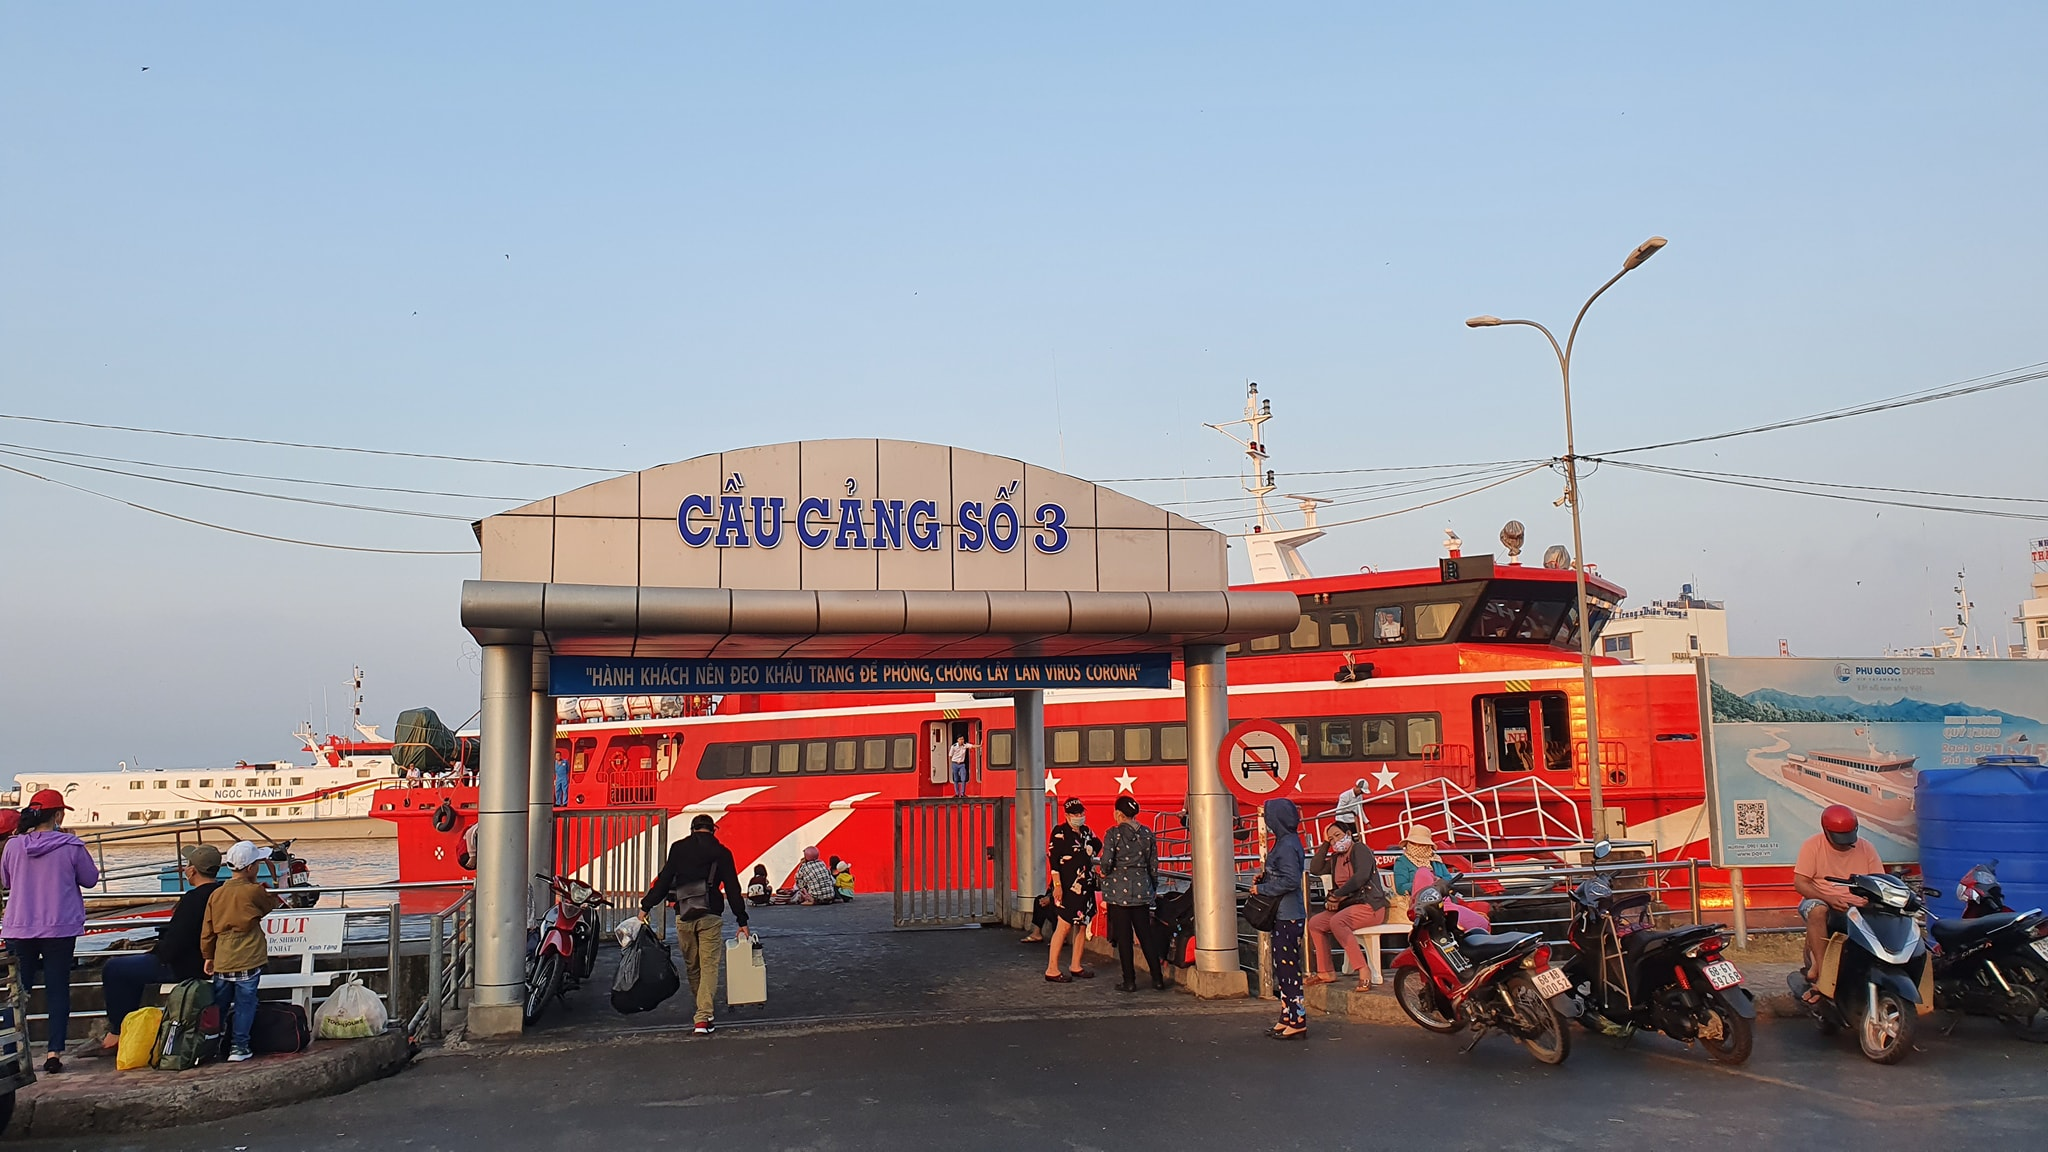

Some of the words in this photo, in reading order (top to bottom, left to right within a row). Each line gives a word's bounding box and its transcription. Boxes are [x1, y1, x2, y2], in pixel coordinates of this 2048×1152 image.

[677, 472, 786, 549] CẦU
[796, 477, 942, 550] CẢNG
[957, 480, 1021, 553] SỐ
[1033, 502, 1069, 554] 3
[640, 664, 689, 686] KHÁCH
[695, 664, 724, 685] NÊN
[730, 666, 759, 685] ĐEO
[765, 661, 803, 684] KHẨU
[809, 665, 855, 684] TRANG
[987, 661, 1009, 681] LÂY
[1015, 665, 1040, 681] LAN
[1044, 665, 1081, 681] VIRUS
[266, 917, 309, 935] ULT
